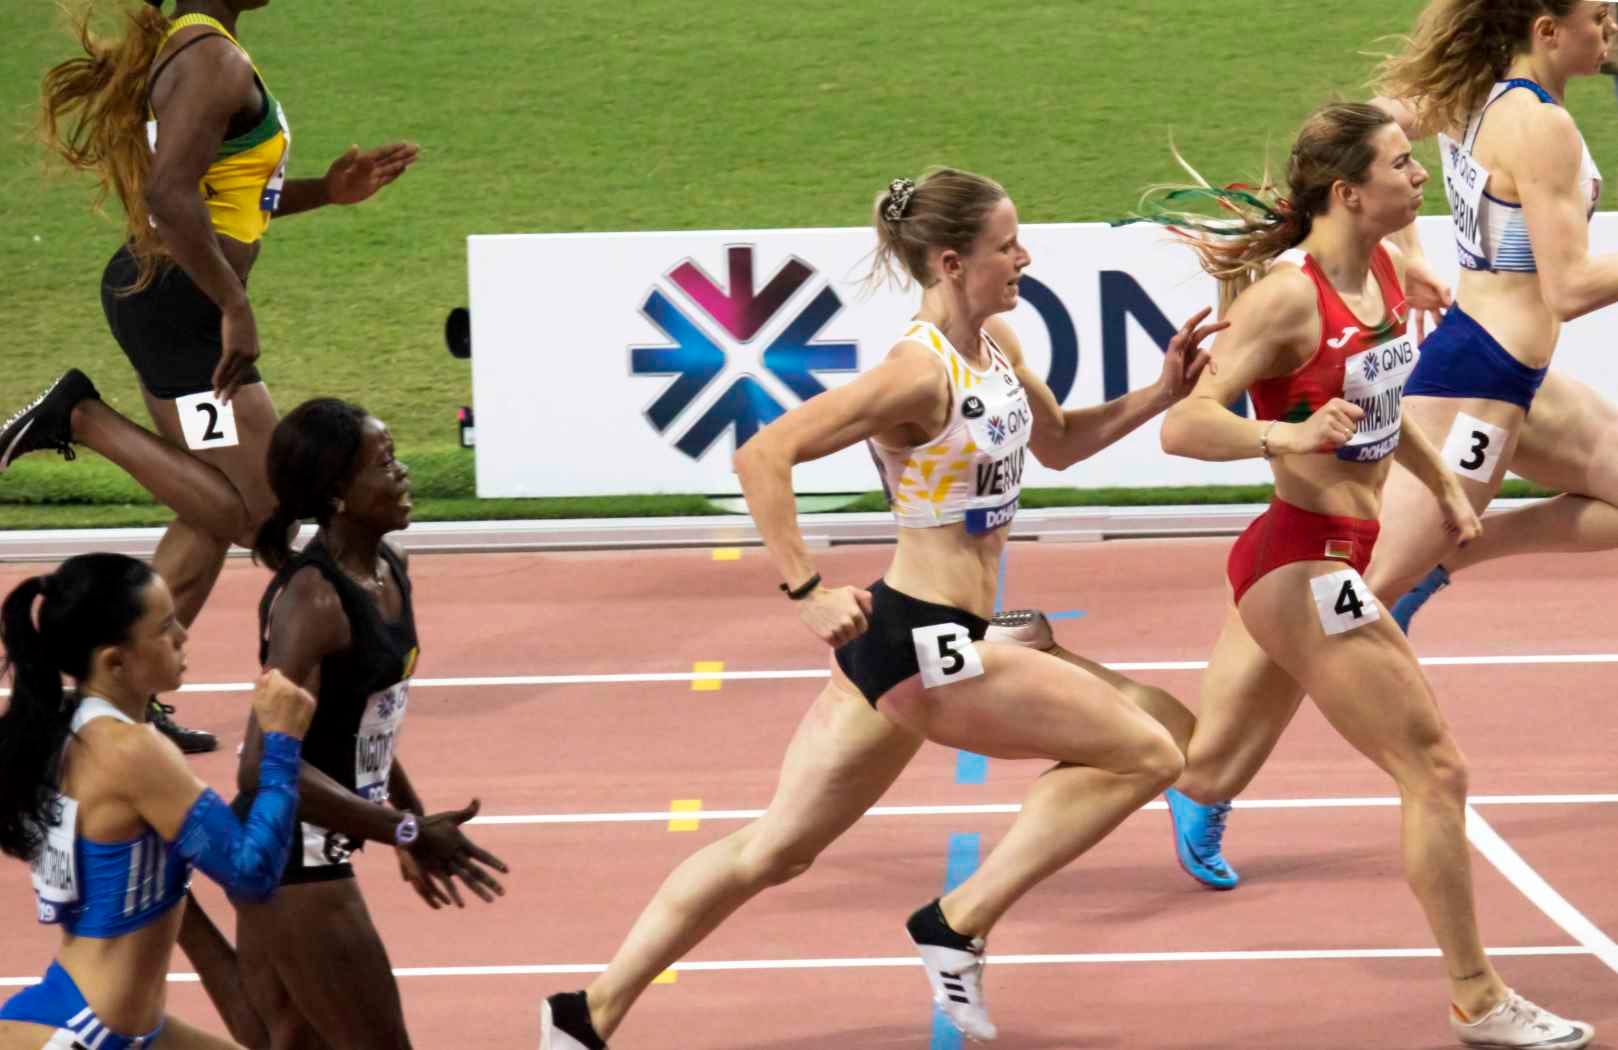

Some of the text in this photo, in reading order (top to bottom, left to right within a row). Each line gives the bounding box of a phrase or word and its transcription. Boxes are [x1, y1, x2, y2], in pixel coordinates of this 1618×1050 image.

[1381, 340, 1413, 372] QNB
[196, 402, 224, 441] 2
[1459, 430, 1490, 471] 3
[1334, 579, 1364, 619] 4
[937, 633, 965, 676] 5
